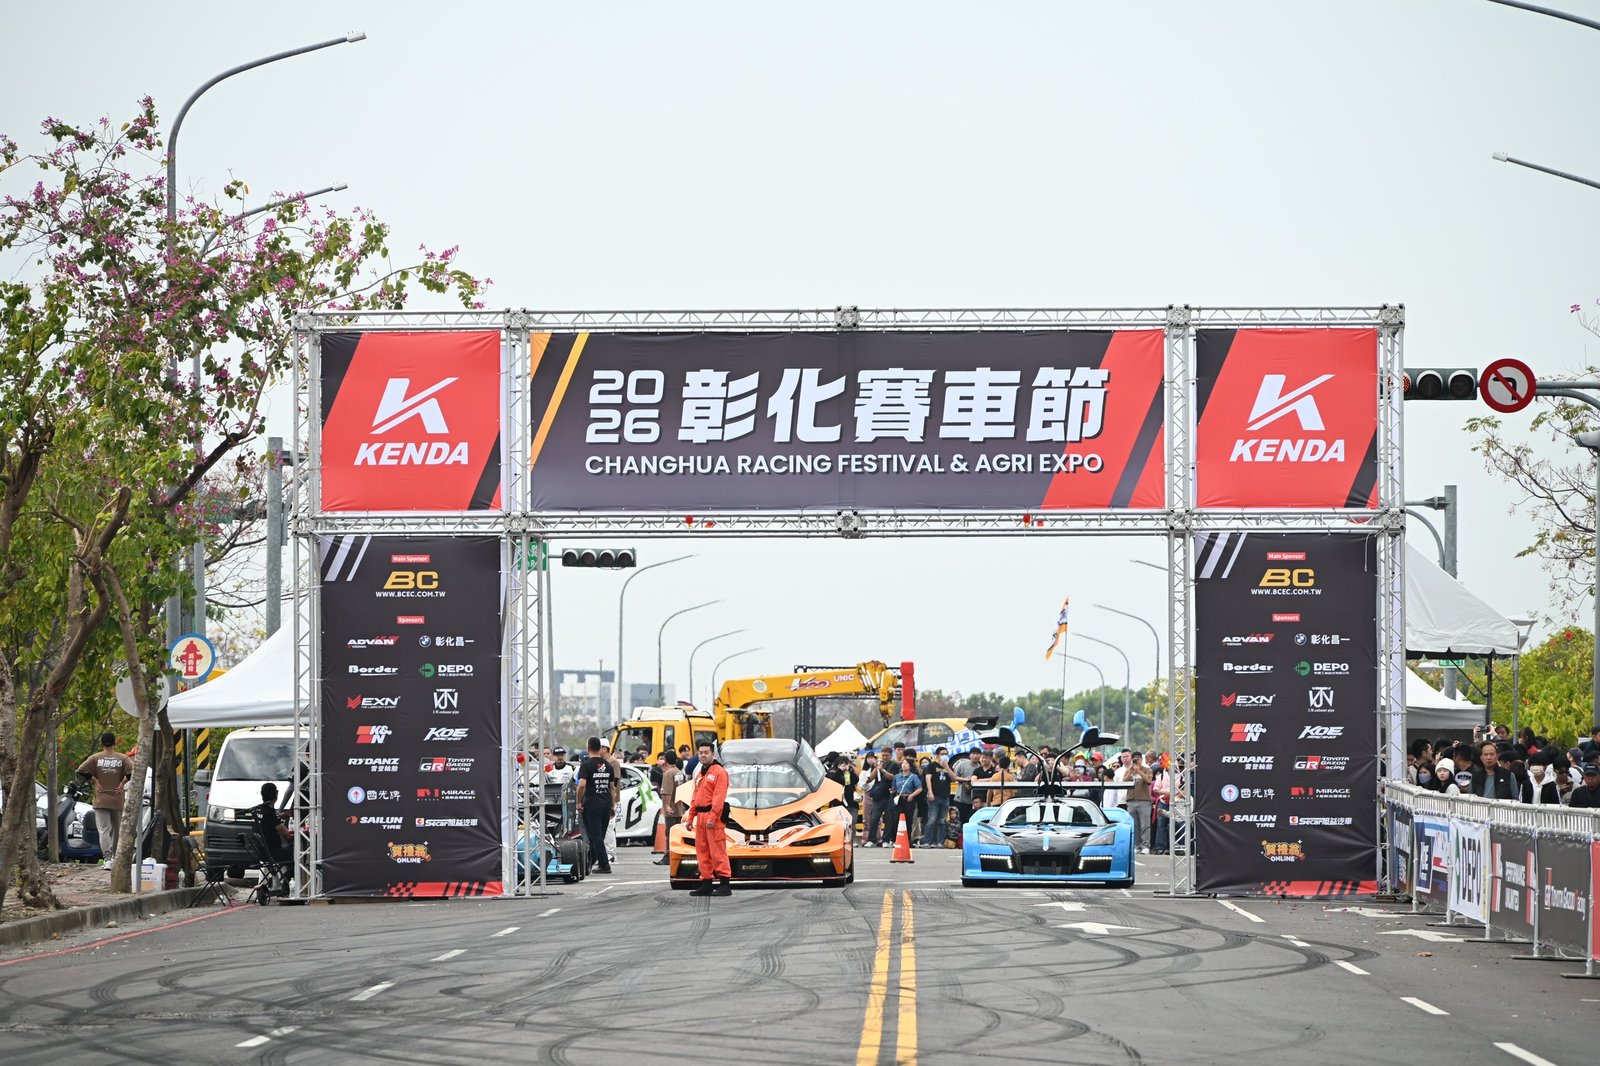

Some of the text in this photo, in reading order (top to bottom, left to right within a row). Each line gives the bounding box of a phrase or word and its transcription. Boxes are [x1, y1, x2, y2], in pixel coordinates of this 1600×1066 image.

[589, 369, 665, 404] 20
[677, 367, 1110, 444] 彰化賽車節
[585, 409, 663, 443] 26
[353, 441, 470, 466] KENDA
[1229, 438, 1346, 463] KENDA
[585, 453, 1104, 475] CHANGHUA RACING FESTIVAL & AGRI EXPO
[383, 571, 439, 589] BC
[1258, 568, 1315, 587] BC
[436, 636, 474, 646] 彰化昌一
[1311, 634, 1350, 644] 彰化昌一
[1314, 663, 1349, 671] DEPO
[833, 674, 855, 682] UNIC
[424, 728, 469, 740] KOE
[1298, 726, 1344, 739] KOE
[420, 763, 444, 771] GR
[1294, 761, 1318, 770] GR
[1462, 836, 1481, 907] DEPO
